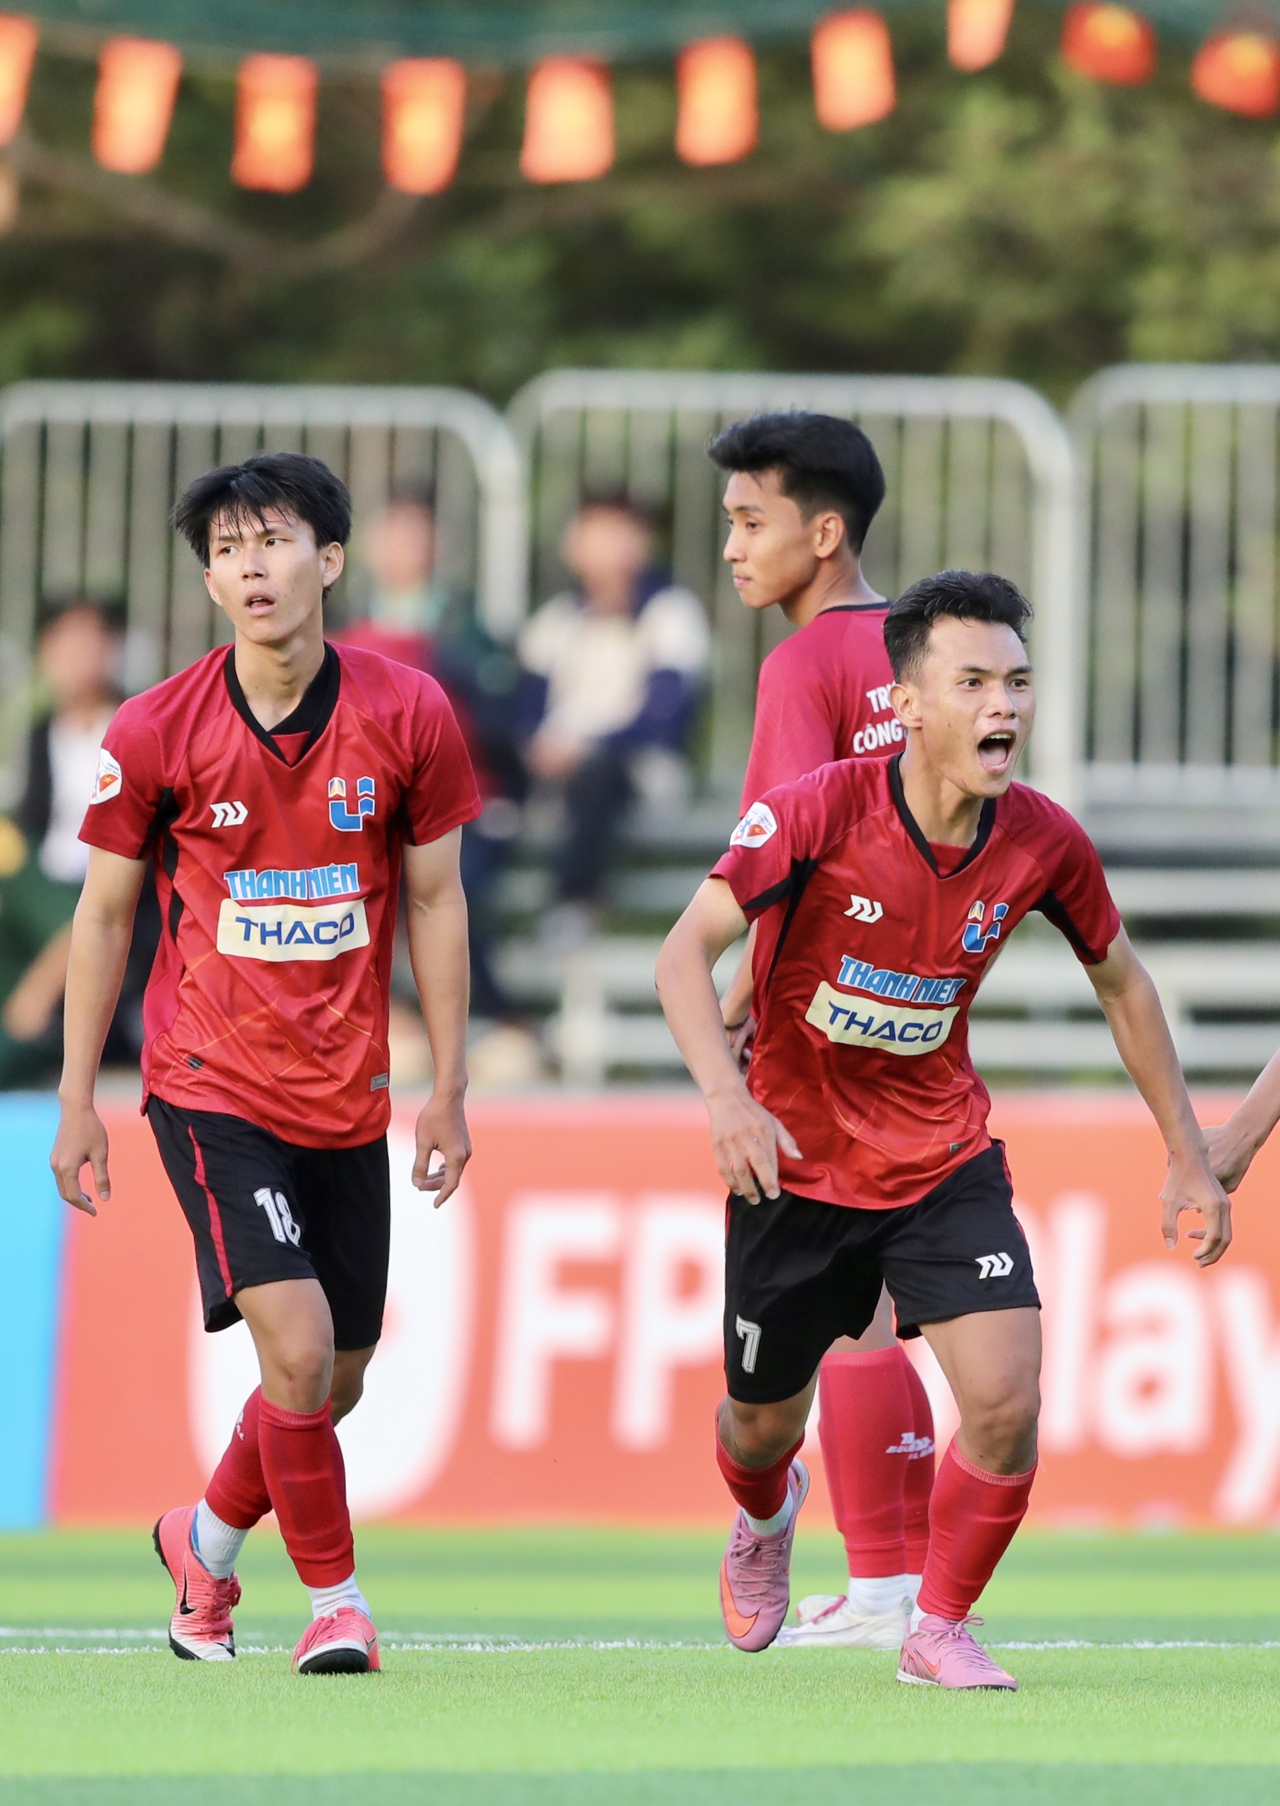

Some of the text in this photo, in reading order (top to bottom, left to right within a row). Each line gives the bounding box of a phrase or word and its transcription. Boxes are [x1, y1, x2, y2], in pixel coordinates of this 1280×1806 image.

[853, 718, 903, 754] CÔNG
[224, 863, 360, 900] THANH NIÊN
[236, 912, 355, 945] THACO
[837, 954, 920, 1001] THANH
[828, 1000, 943, 1042] THACO
[253, 1187, 301, 1248] 18
[490, 1188, 727, 1450] FP
[735, 1313, 762, 1374] 7
